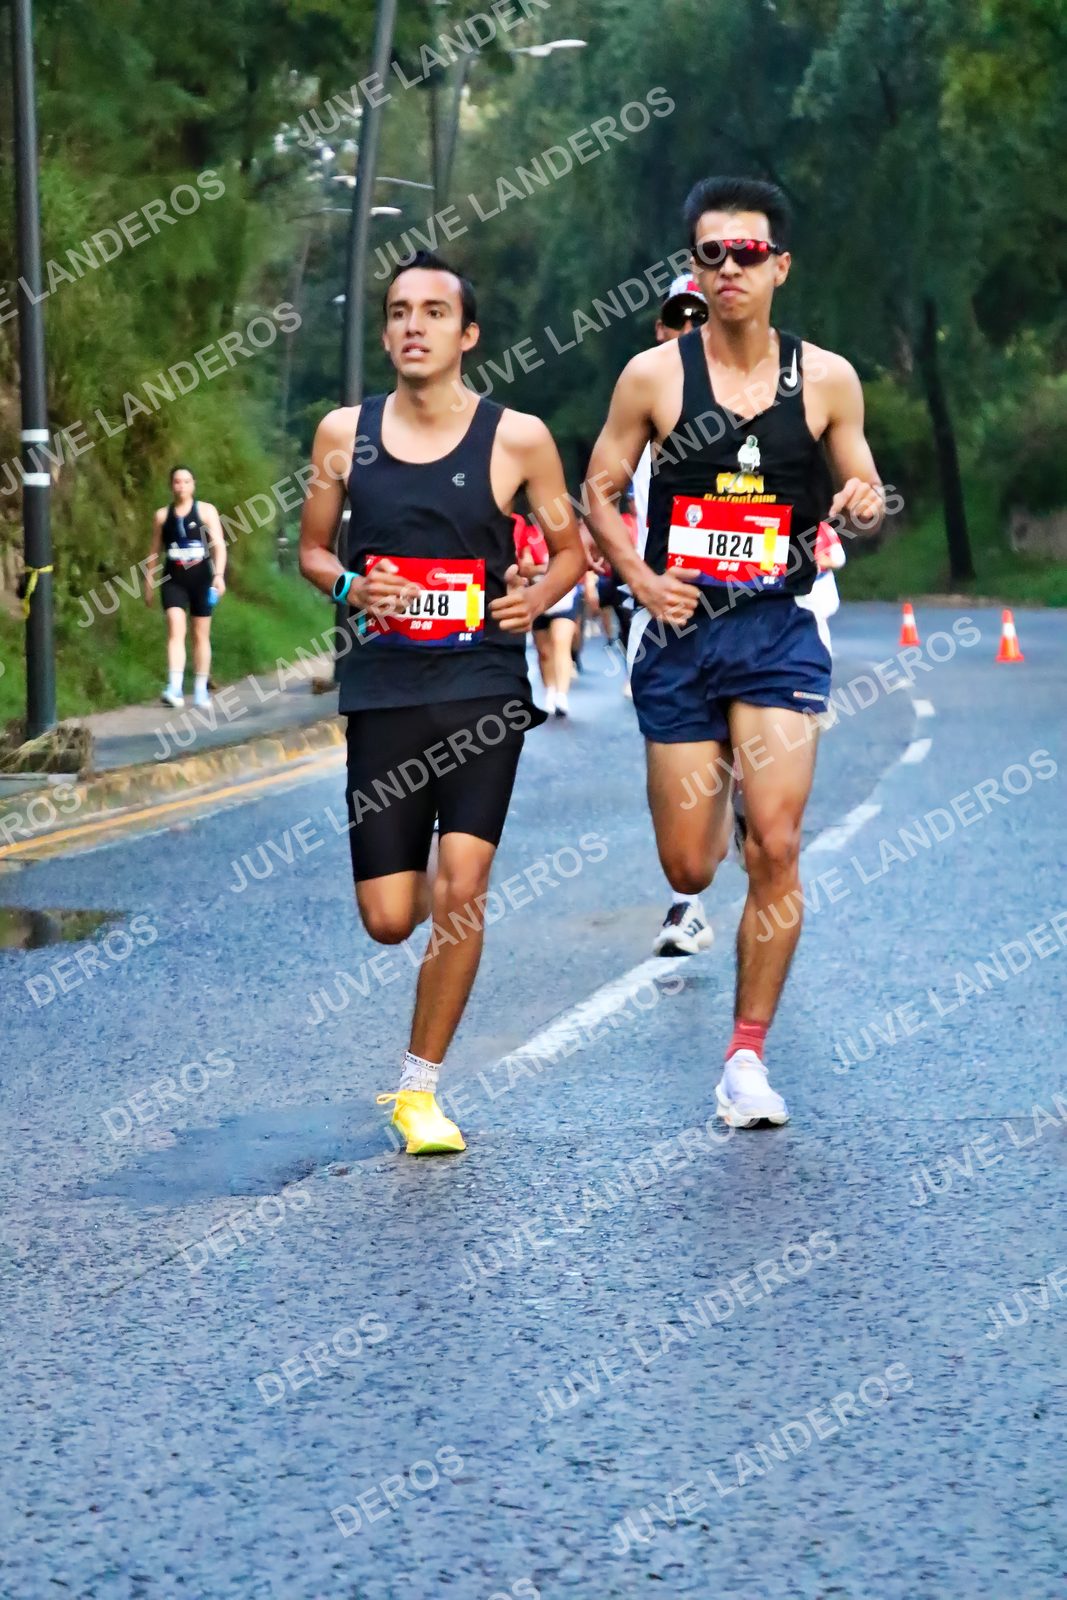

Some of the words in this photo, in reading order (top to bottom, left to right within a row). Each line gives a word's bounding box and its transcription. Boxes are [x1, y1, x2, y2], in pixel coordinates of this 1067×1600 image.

[716, 473, 764, 494] RUN
[707, 533, 754, 558] 1824
[401, 593, 449, 616] 048
